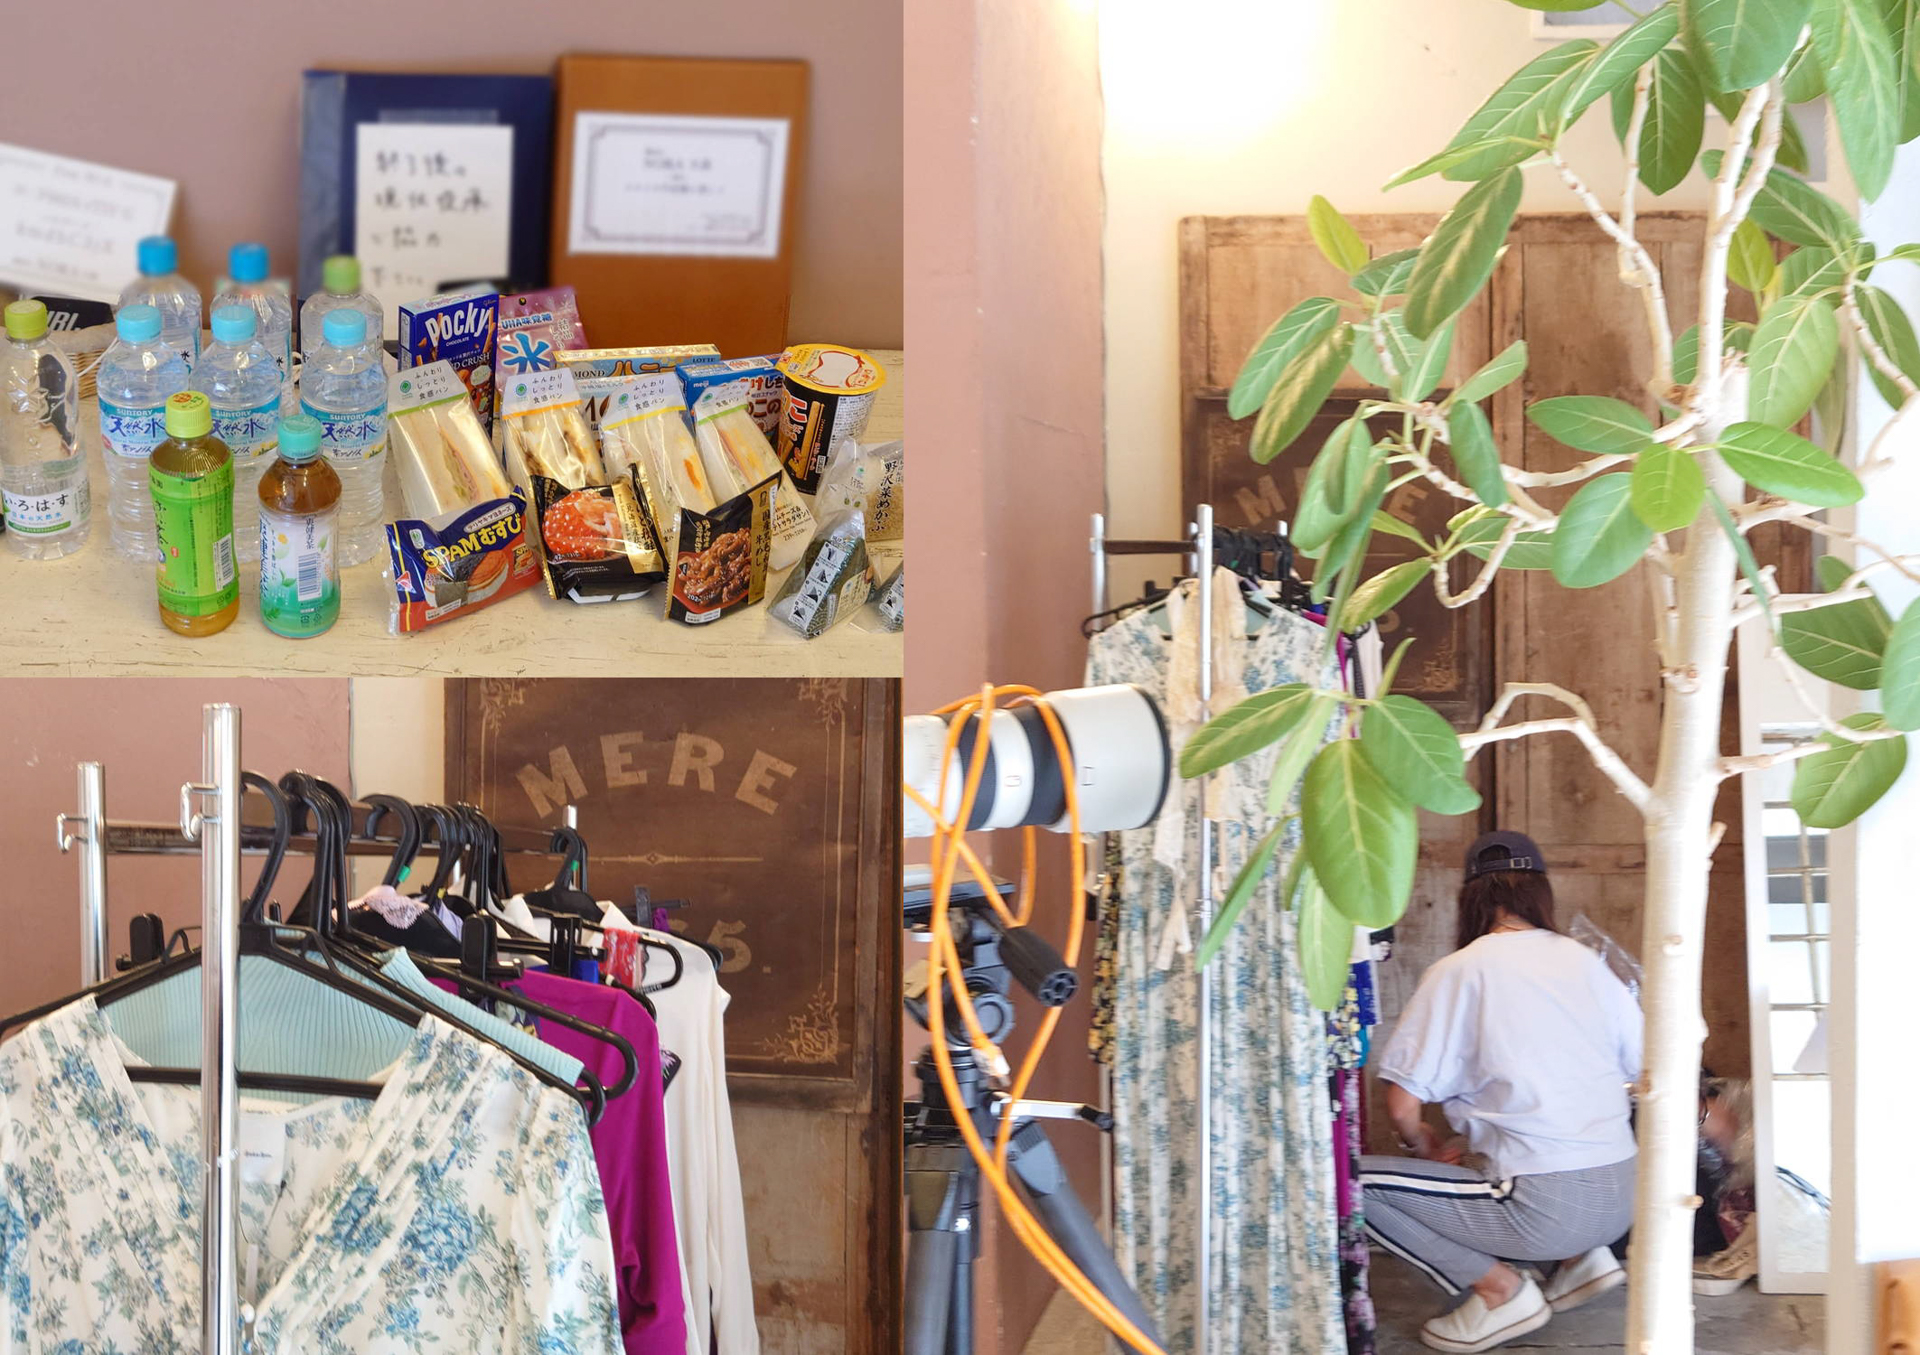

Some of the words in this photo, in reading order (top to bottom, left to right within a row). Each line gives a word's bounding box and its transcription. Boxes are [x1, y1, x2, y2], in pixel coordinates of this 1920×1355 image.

[446, 337, 469, 347] CHOCOLATE
[461, 352, 490, 368] CRUSH
[414, 367, 442, 379] ふんわり
[532, 374, 563, 384] ふんわり
[574, 370, 605, 378] MOND
[416, 376, 446, 389] しっとり
[532, 383, 563, 394] しっとり
[633, 379, 665, 391] ふんわり
[419, 386, 449, 399] 食感パン
[533, 393, 563, 404] 食感パン
[633, 388, 664, 400] しっとり
[635, 398, 665, 411] 食感パン
[116, 408, 153, 416] SUNTORY
[330, 413, 366, 421] SUNTORY
[109, 415, 166, 438] 天然水
[210, 417, 266, 438] 天然水
[321, 421, 377, 442] 天然水
[515, 731, 798, 819] MERE
[672, 919, 772, 974] 5.
